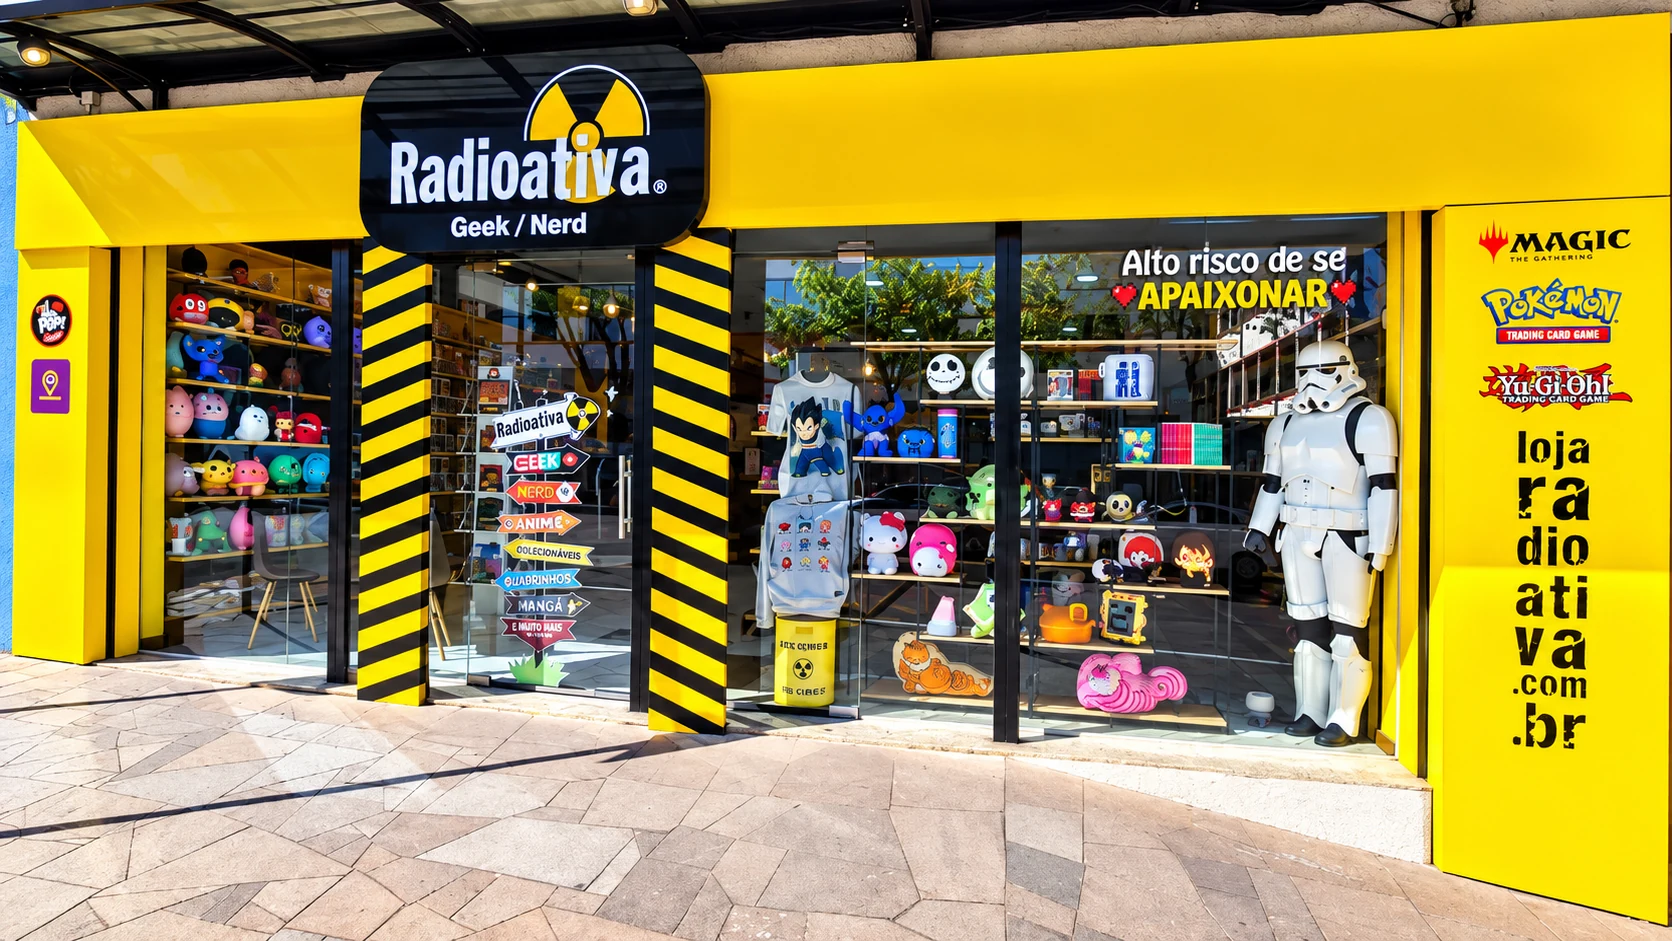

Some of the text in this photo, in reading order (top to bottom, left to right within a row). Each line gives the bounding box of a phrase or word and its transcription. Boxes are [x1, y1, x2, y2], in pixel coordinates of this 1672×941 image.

[450, 214, 510, 238] Geek
[531, 211, 587, 235] Nerd
[1509, 229, 1631, 253] MAGIC
[1122, 245, 1347, 276] Alto risco de se
[1534, 254, 1593, 262] GATHERING
[1138, 278, 1328, 310] APAIXONAR
[1506, 329, 1600, 340] TRADING CARD GAME
[1502, 395, 1609, 403] TRADING CARD GAME
[496, 410, 564, 438] Radioativa
[1517, 430, 1590, 470] loja
[517, 486, 554, 499] NERD
[1518, 476, 1590, 521] ra
[515, 516, 563, 530] ANIME
[1517, 526, 1589, 566] dio
[518, 597, 562, 612] MANGÁ
[1515, 575, 1587, 619] ati
[512, 622, 517, 632] E
[1514, 626, 1586, 670] va
[1512, 673, 1587, 699] .com
[1512, 702, 1586, 750] .br
